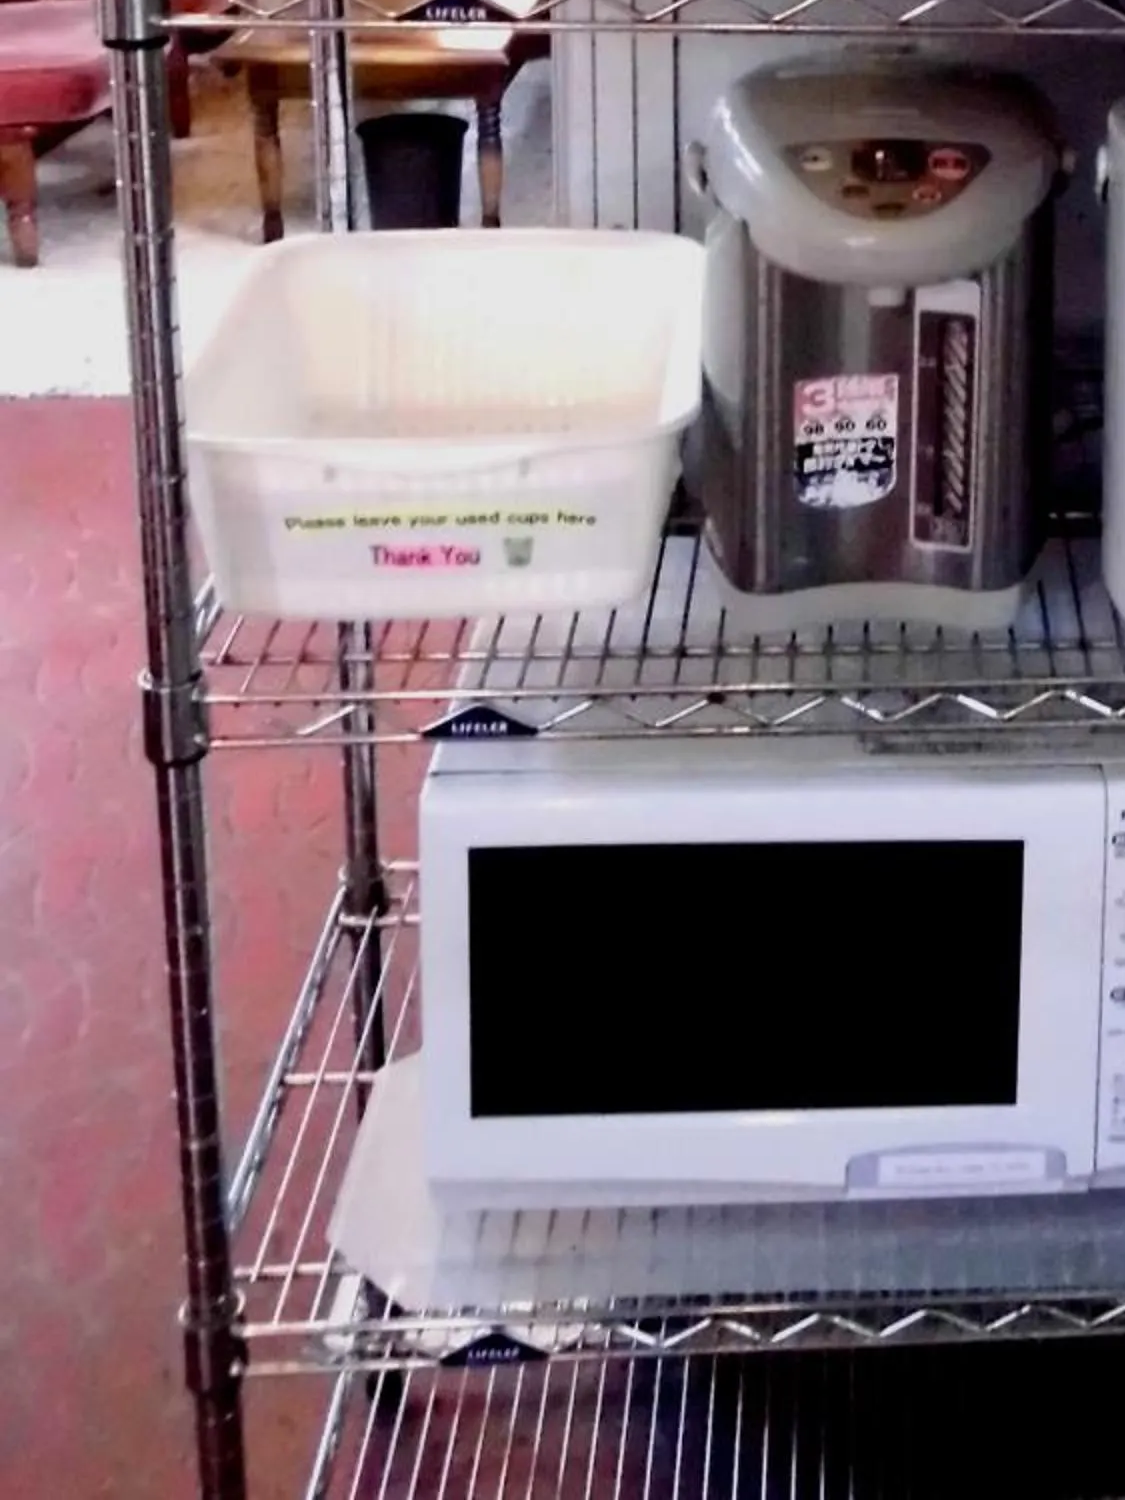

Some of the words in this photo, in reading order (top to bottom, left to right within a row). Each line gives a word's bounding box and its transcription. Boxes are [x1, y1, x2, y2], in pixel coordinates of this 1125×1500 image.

[284, 516, 345, 530] Please
[353, 514, 401, 527] leave
[409, 514, 447, 528] your
[455, 512, 500, 526] used
[507, 512, 549, 526] cups
[556, 511, 596, 526] here
[369, 544, 432, 566] Thank
[440, 545, 481, 566] You
